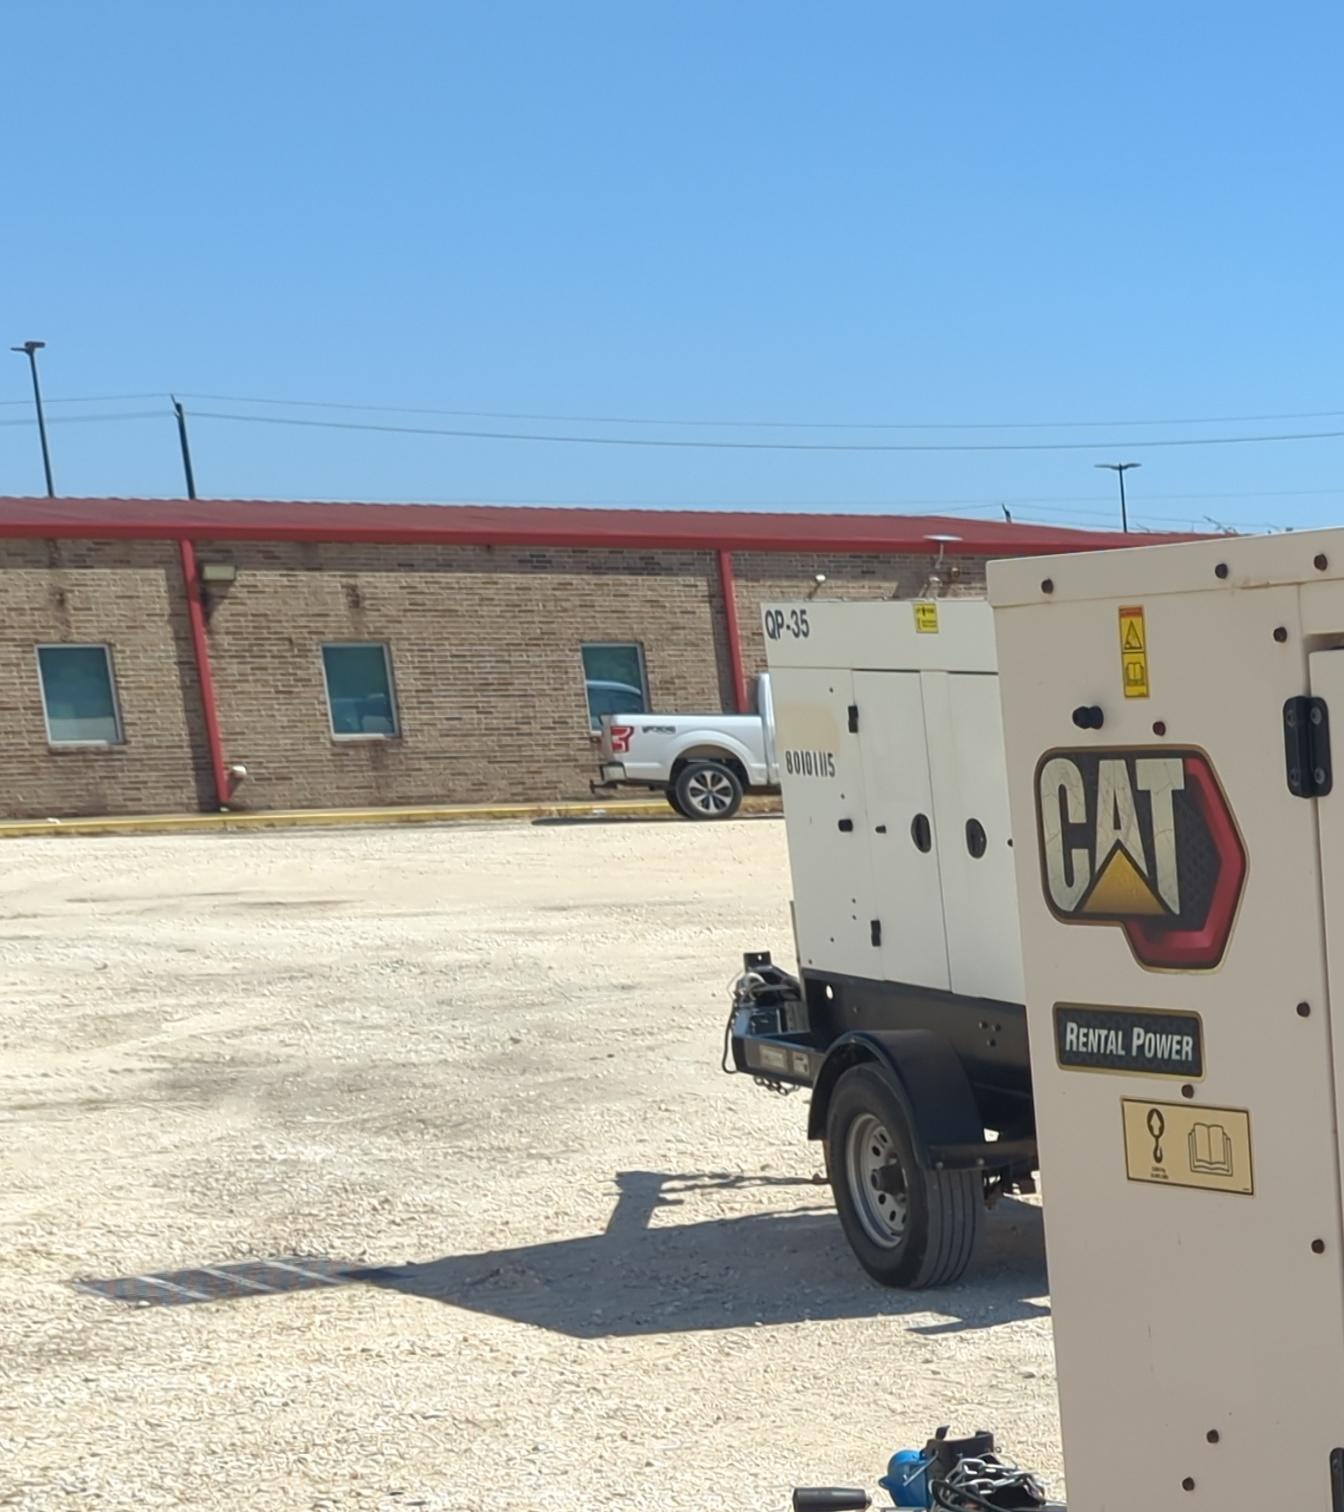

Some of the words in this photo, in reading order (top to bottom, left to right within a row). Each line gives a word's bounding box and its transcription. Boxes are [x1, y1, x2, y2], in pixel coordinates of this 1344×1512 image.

[765, 609, 810, 640] QP-35
[1040, 758, 1185, 915] CAT
[1065, 1021, 1126, 1056] RENTAL
[1132, 1027, 1193, 1061] POWER
